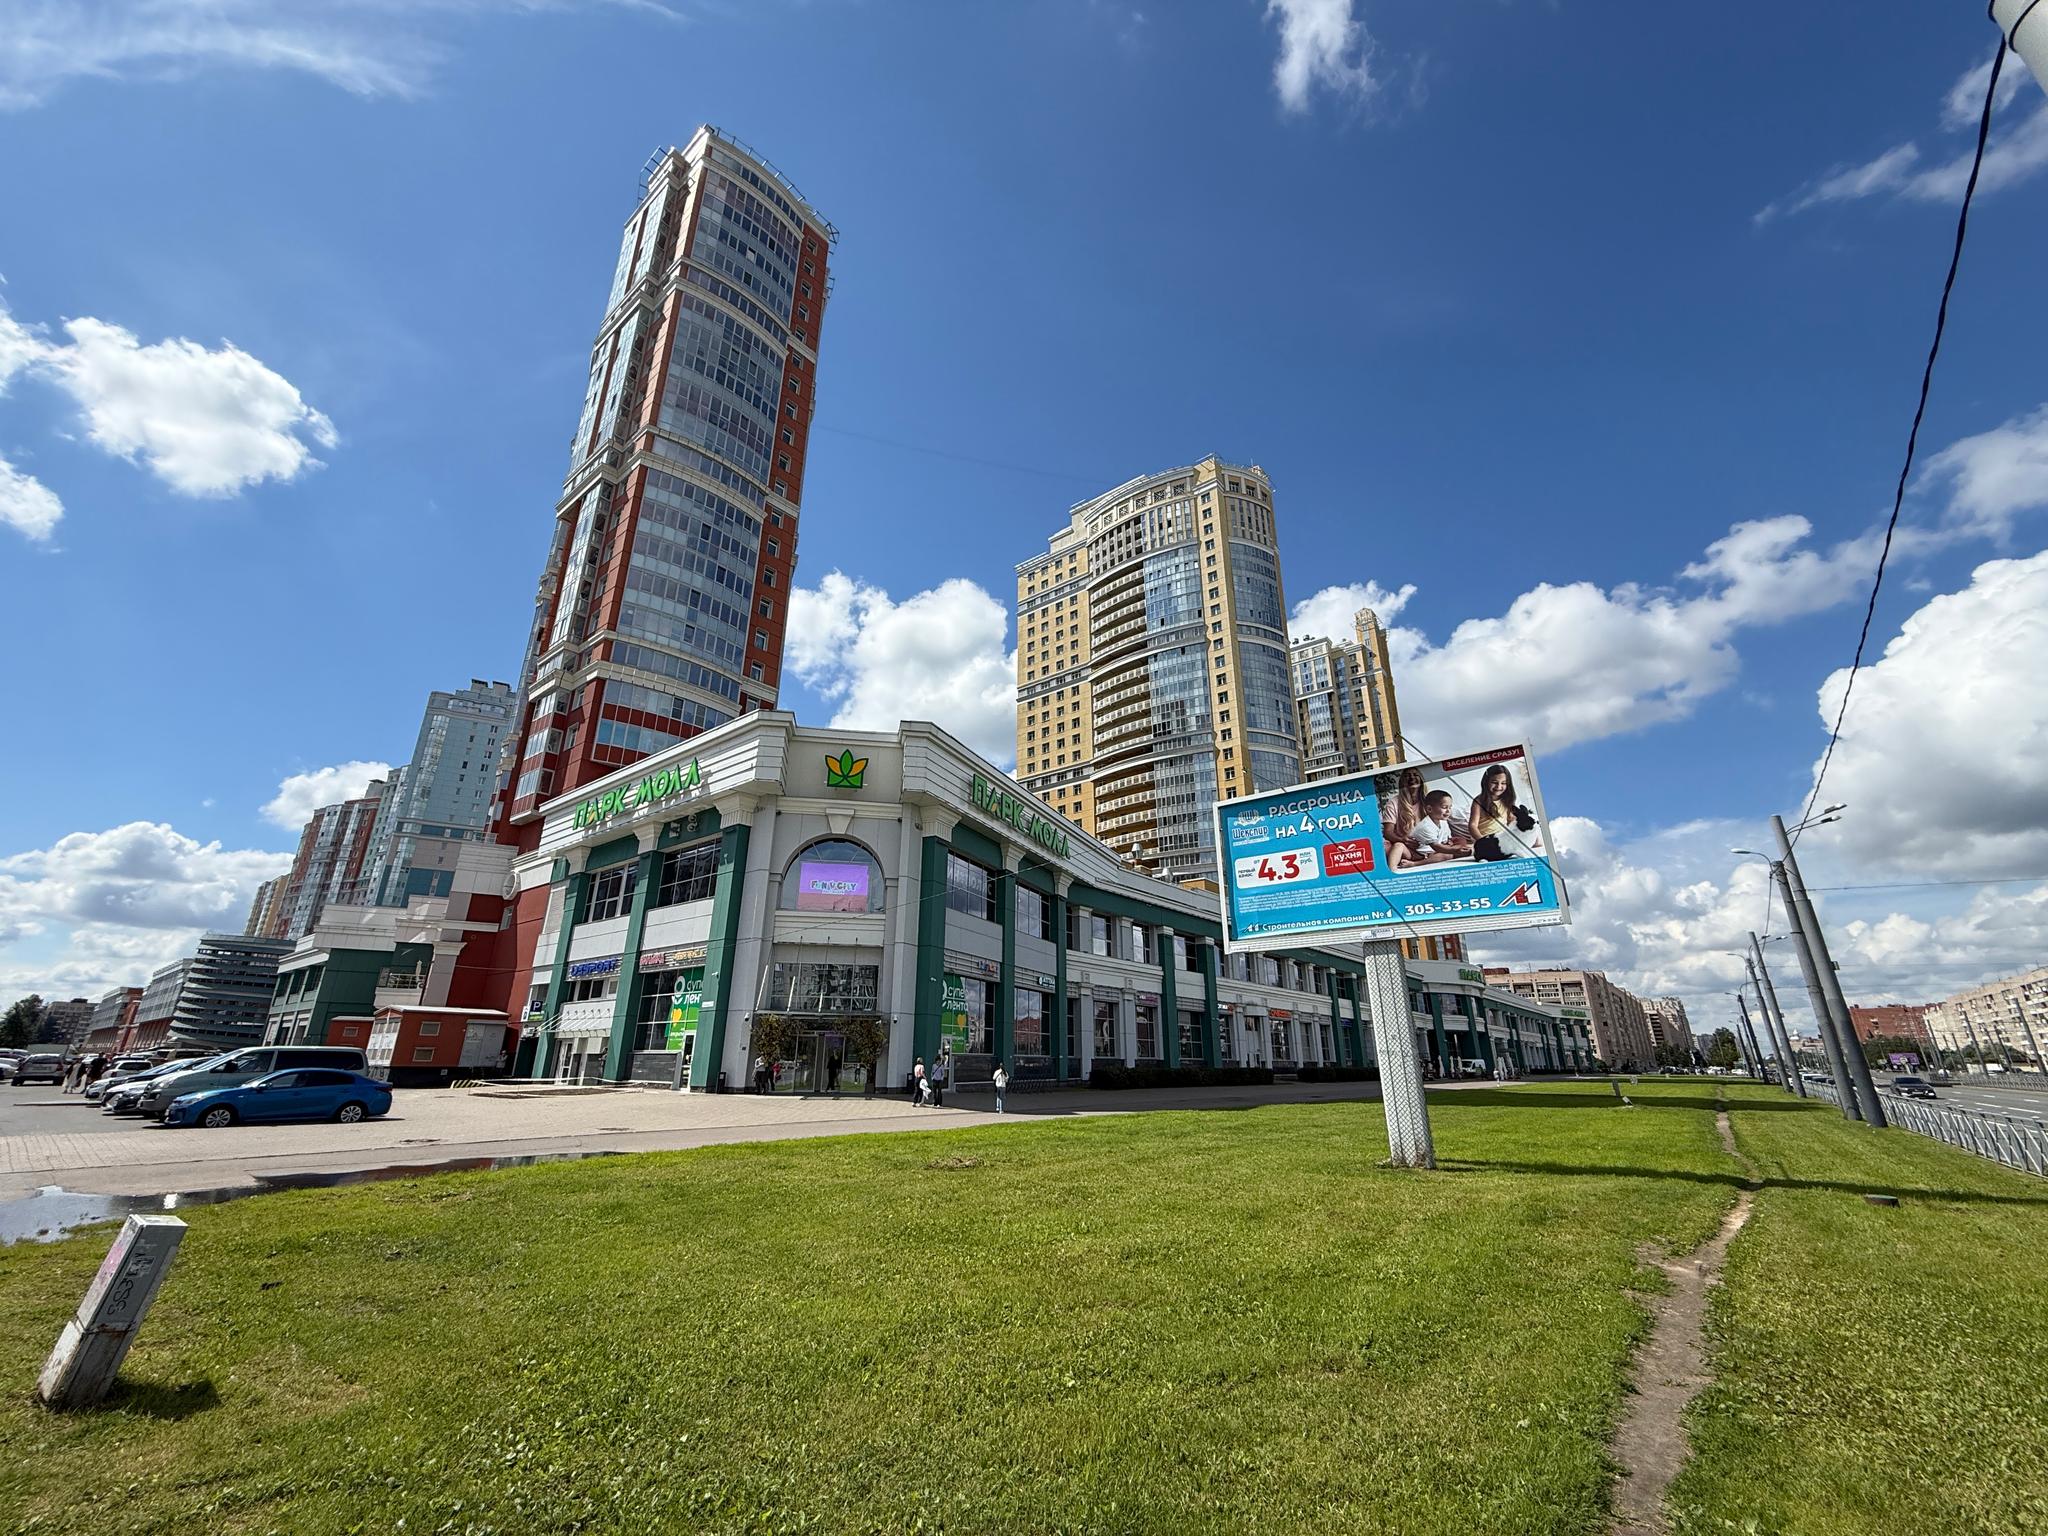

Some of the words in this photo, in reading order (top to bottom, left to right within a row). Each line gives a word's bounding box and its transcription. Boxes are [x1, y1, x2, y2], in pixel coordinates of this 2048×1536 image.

[1446, 755, 1491, 768] ЗАСЕЛЕНИЕ
[1491, 748, 1520, 760] СРАЗУ!
[573, 783, 631, 830] ПАРК
[633, 757, 700, 808] МОЛЛ
[1268, 789, 1364, 818] РАССРОЧКА
[972, 774, 1025, 832] ПАРК
[1028, 813, 1070, 859] МОЛЛ
[1275, 824, 1298, 838] НА
[1299, 815, 1315, 833] 4
[1317, 812, 1364, 831] ГОДА
[1231, 826, 1269, 839] Шекспир
[1258, 853, 1300, 881] 4.3
[1333, 852, 1362, 863] кухня
[1404, 897, 1492, 916] 305-33-55
[1262, 919, 1321, 932] Строительная
[1323, 914, 1370, 925] компания
